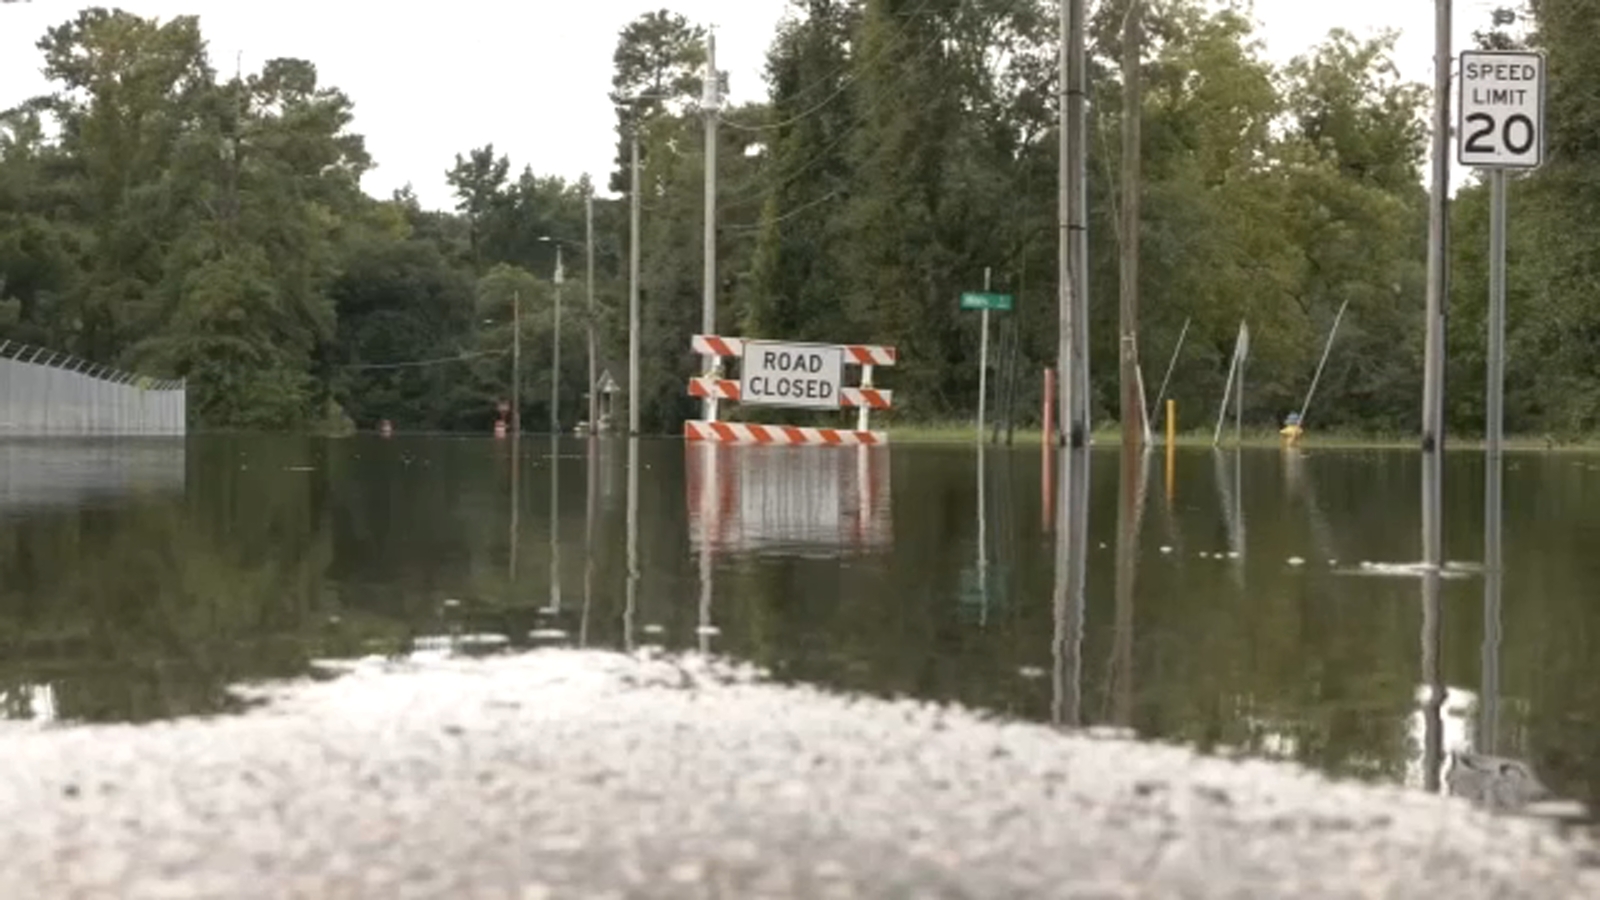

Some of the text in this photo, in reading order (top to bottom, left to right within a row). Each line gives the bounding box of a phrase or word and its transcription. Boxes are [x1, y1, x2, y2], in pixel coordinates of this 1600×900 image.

[1466, 63, 1535, 81] SPEED
[1473, 88, 1527, 106] LIMIT
[1465, 112, 1534, 155] 20
[764, 352, 823, 373] ROAD
[749, 376, 832, 399] CLOSED
